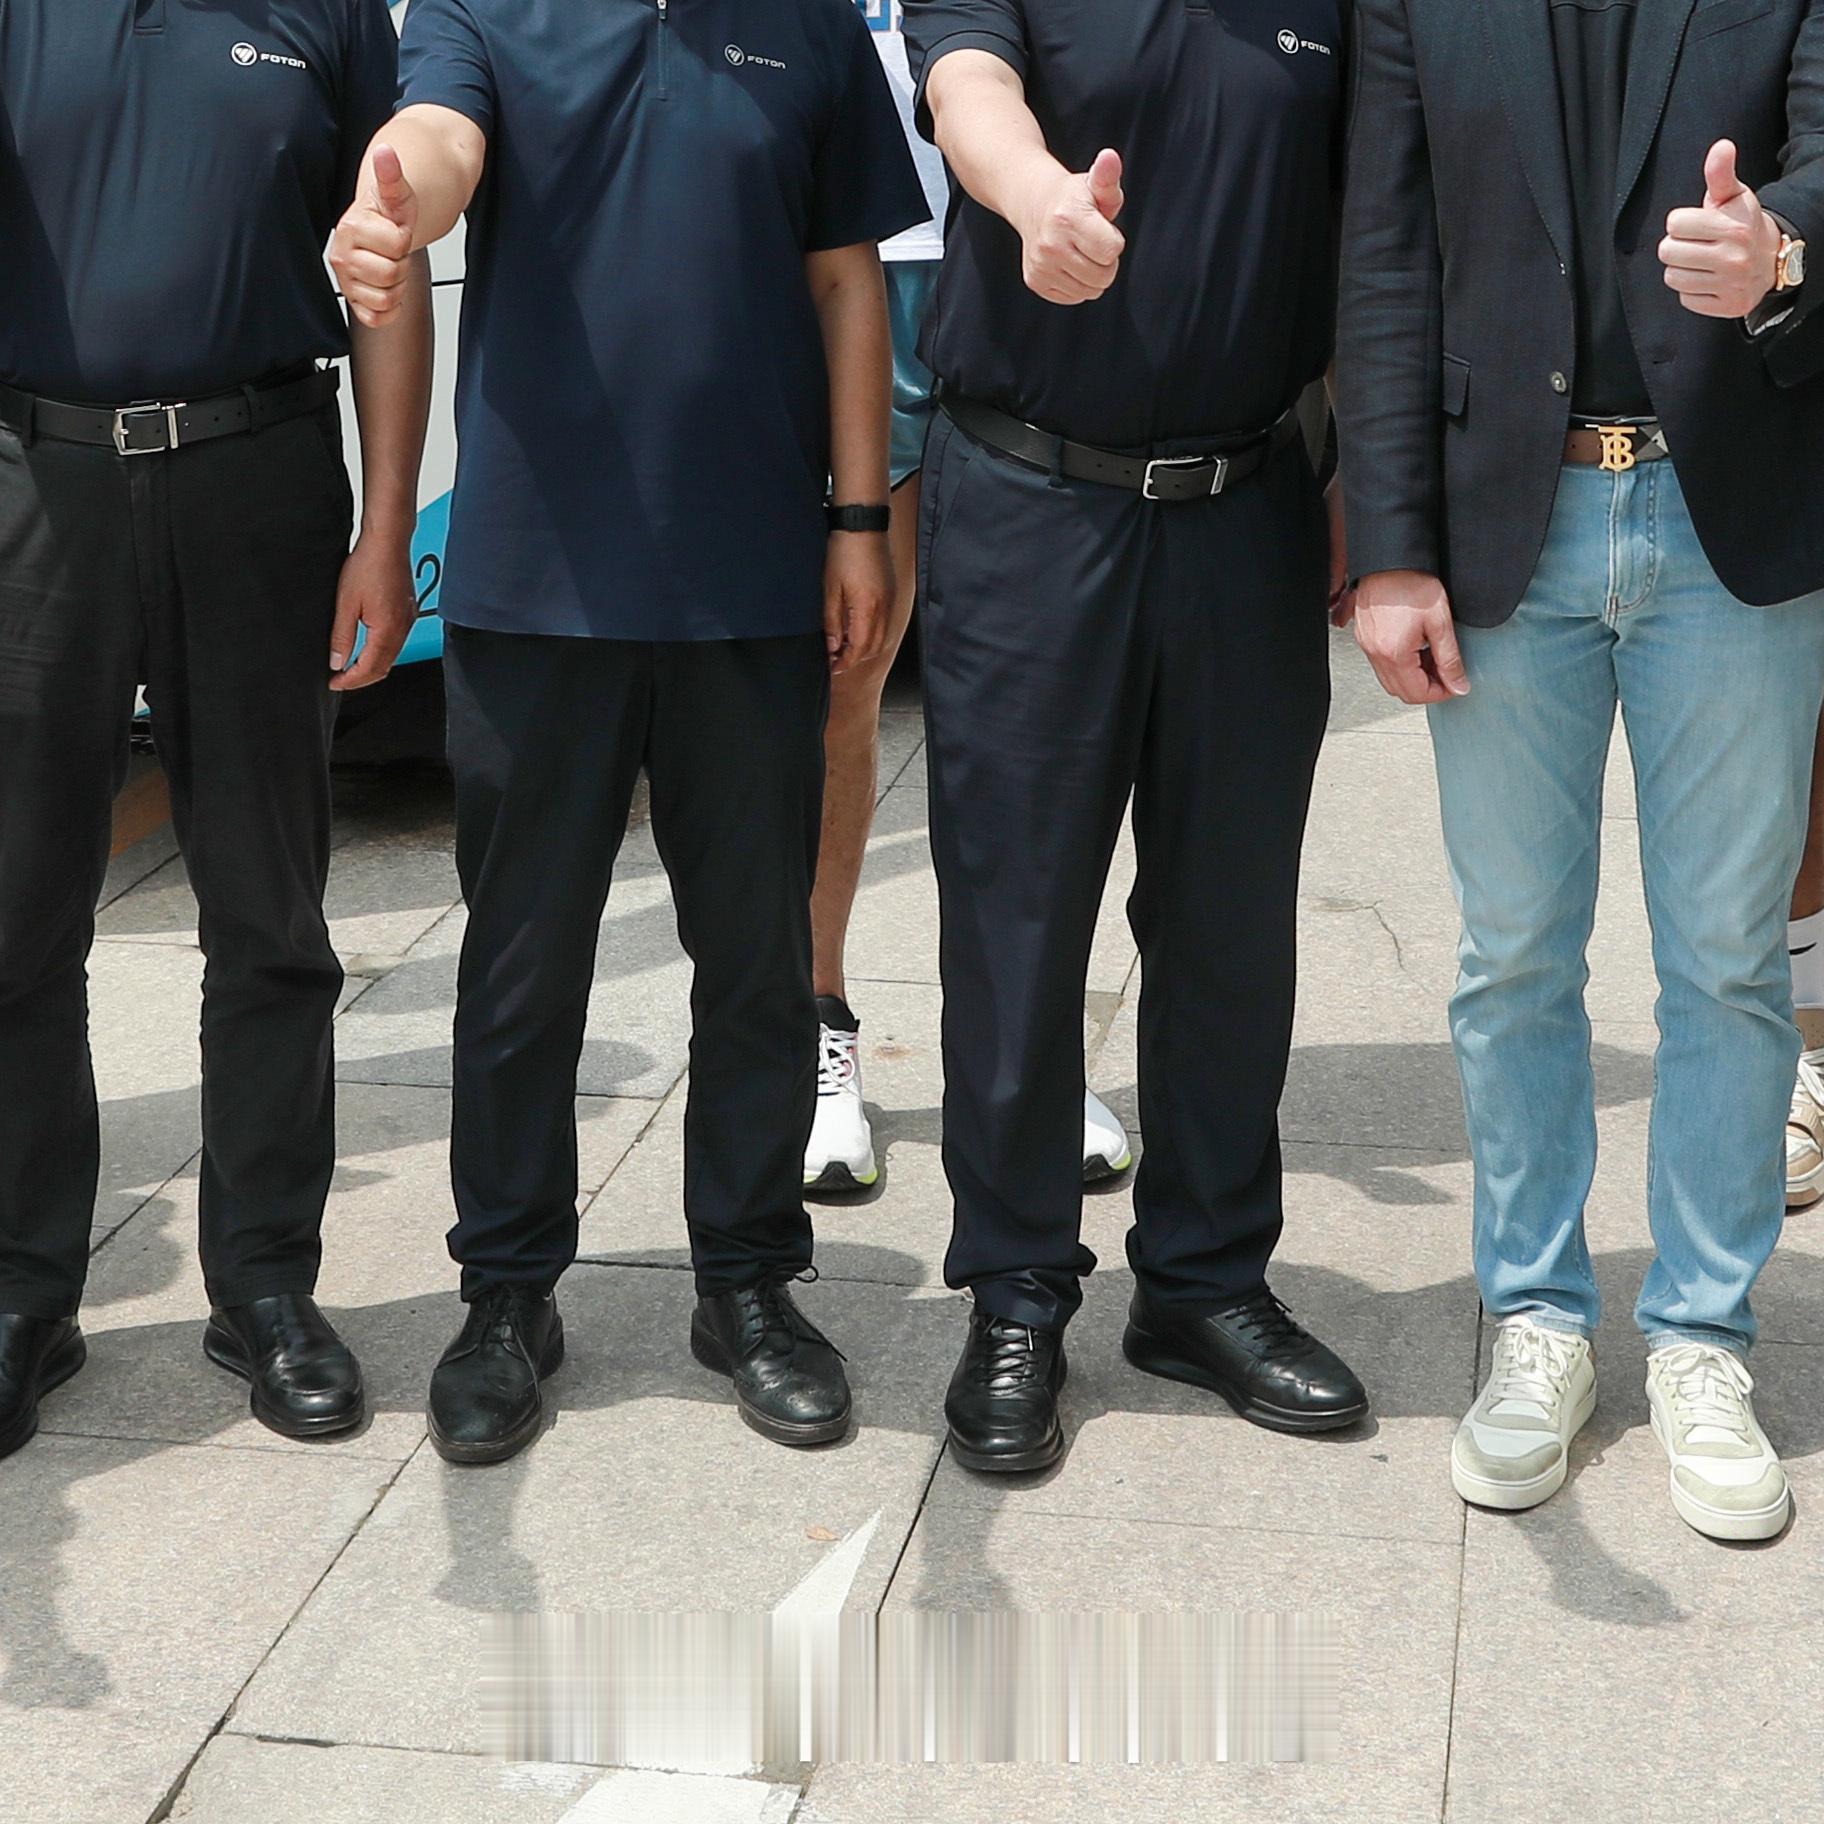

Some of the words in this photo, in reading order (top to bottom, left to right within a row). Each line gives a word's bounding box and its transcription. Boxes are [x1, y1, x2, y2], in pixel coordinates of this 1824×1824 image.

[1300, 40, 1332, 55] FOTON
[260, 53, 307, 70] FOTON
[747, 55, 787, 70] FOTON
